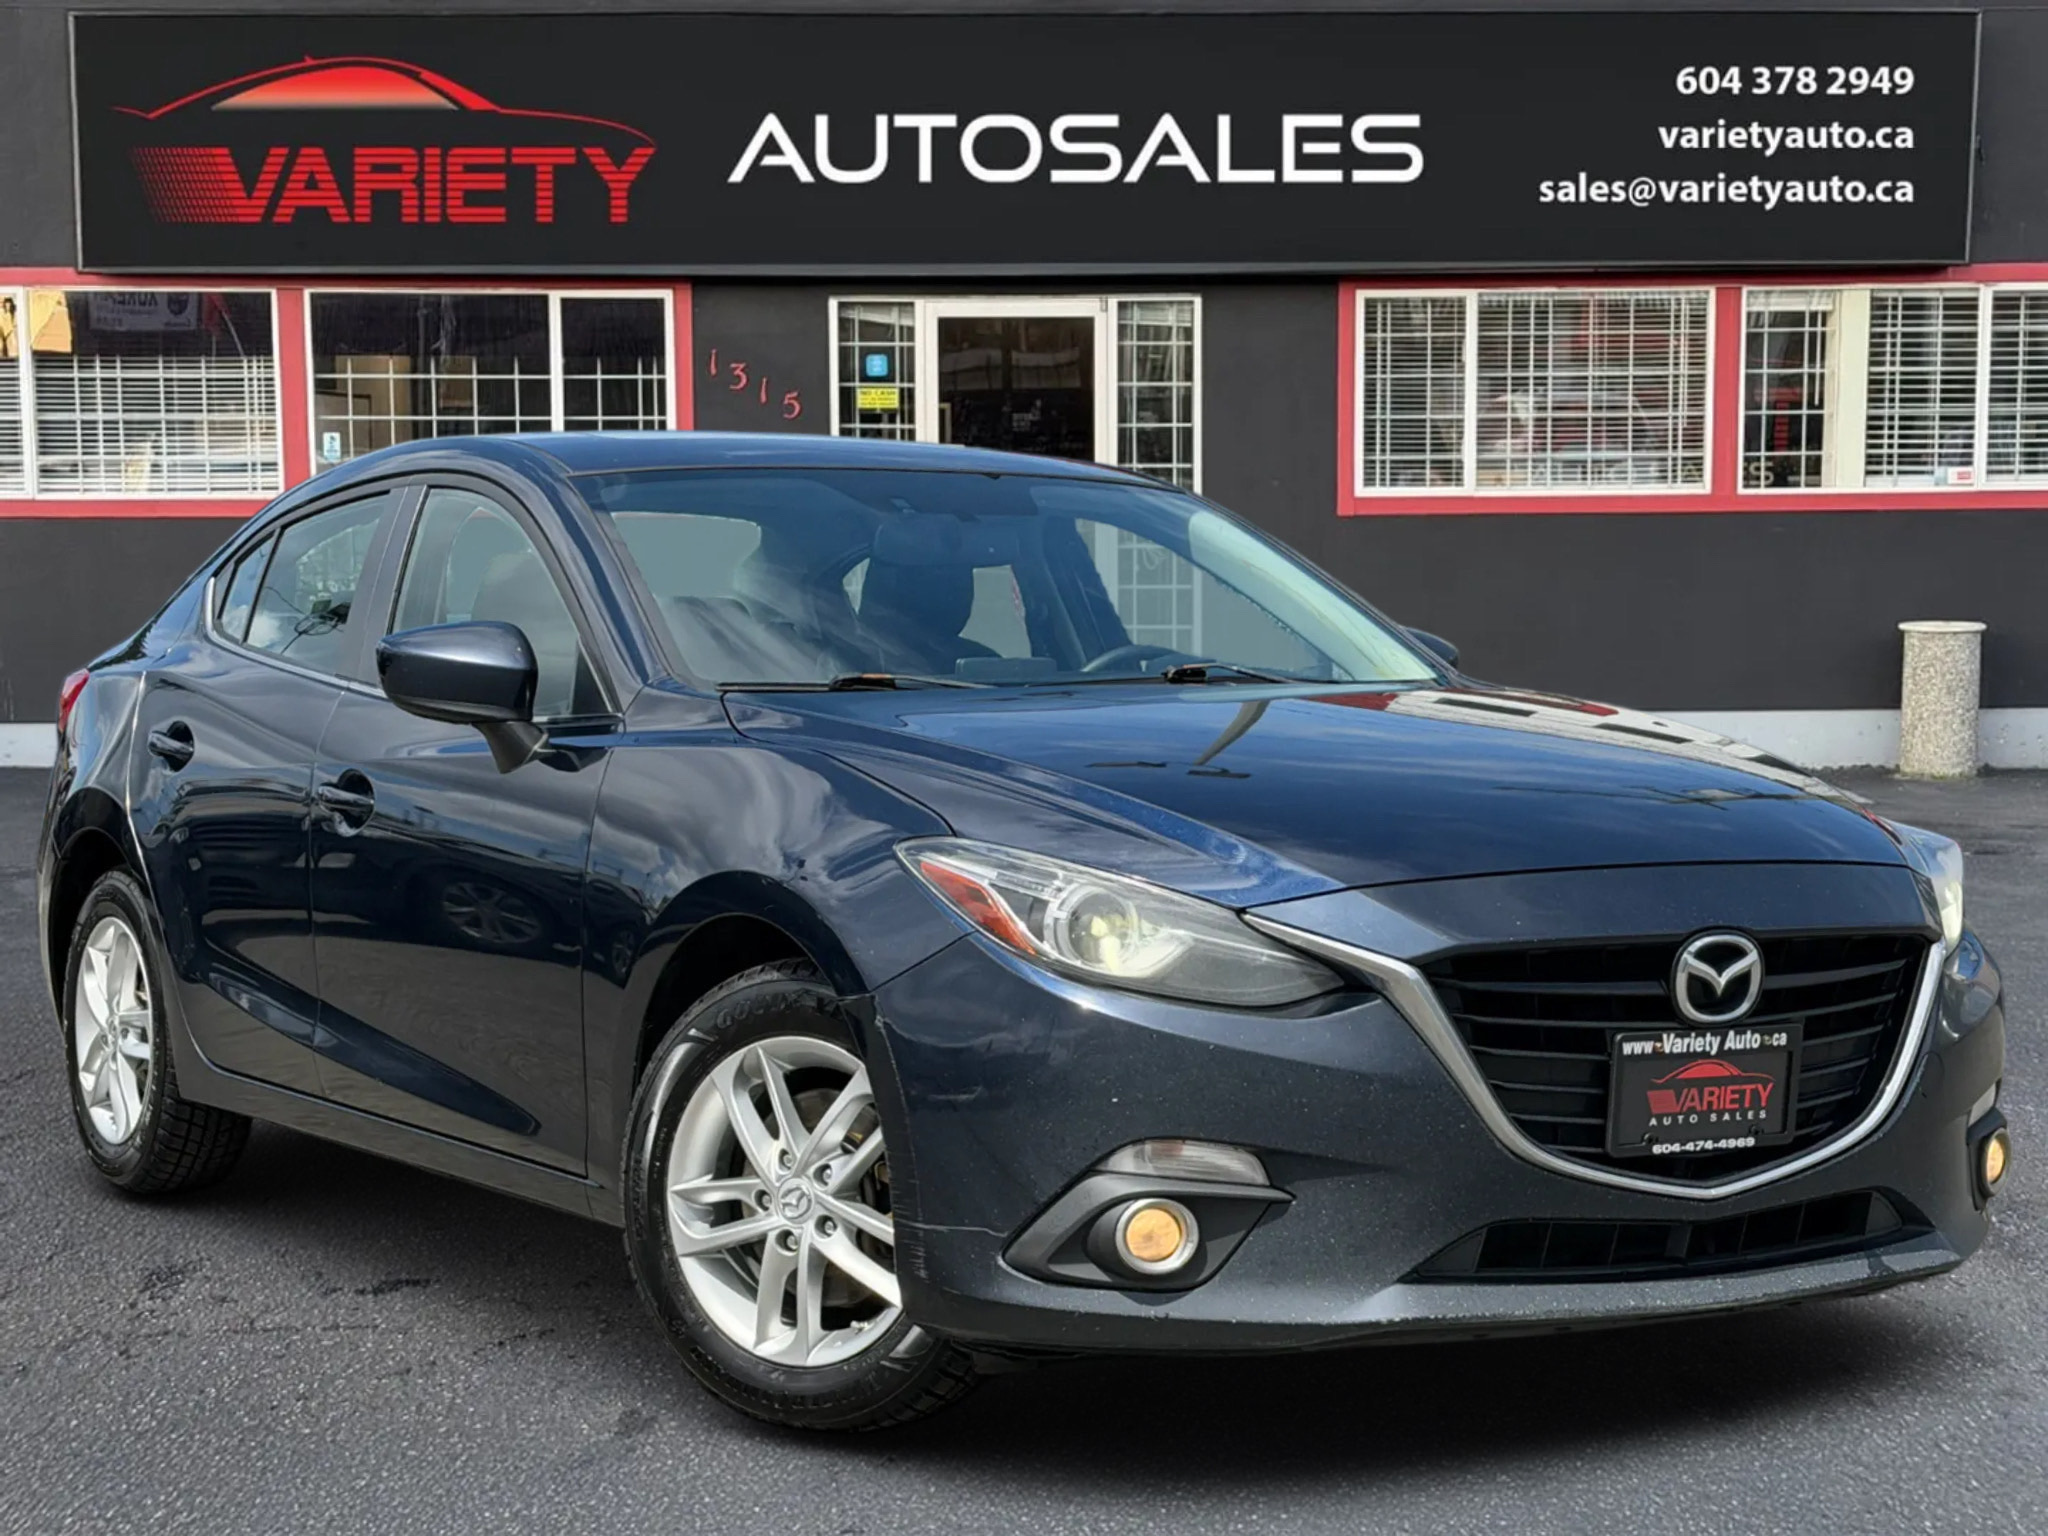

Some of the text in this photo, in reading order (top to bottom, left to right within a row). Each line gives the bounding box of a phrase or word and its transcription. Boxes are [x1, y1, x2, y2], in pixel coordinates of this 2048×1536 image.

[1675, 65, 1915, 95] 604 378 2949
[727, 112, 1424, 184] AUTOSALES
[1657, 118, 1914, 158] varietyauto.ca
[150, 145, 657, 225] VARIETY
[1539, 171, 1914, 211] sales@varietyauto.ca
[709, 348, 802, 420] 1315
[1647, 1082, 1775, 1115] VARIETY
[1648, 1109, 1767, 1127] AUTO SALES
